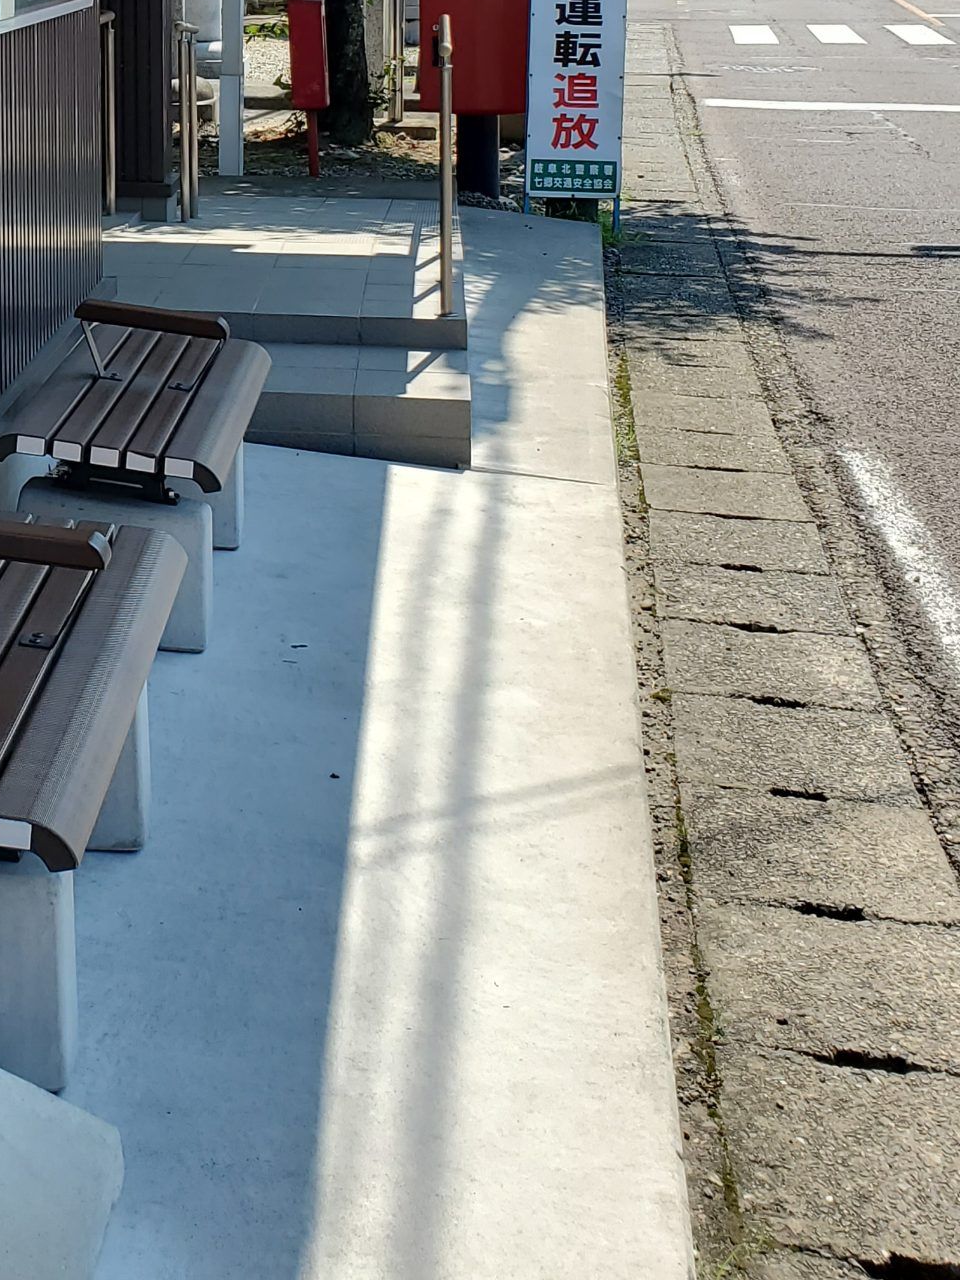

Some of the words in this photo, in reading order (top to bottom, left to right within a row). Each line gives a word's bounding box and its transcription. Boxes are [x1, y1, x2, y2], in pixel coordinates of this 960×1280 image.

[534, 163, 613, 176] 岐阜北警察署
